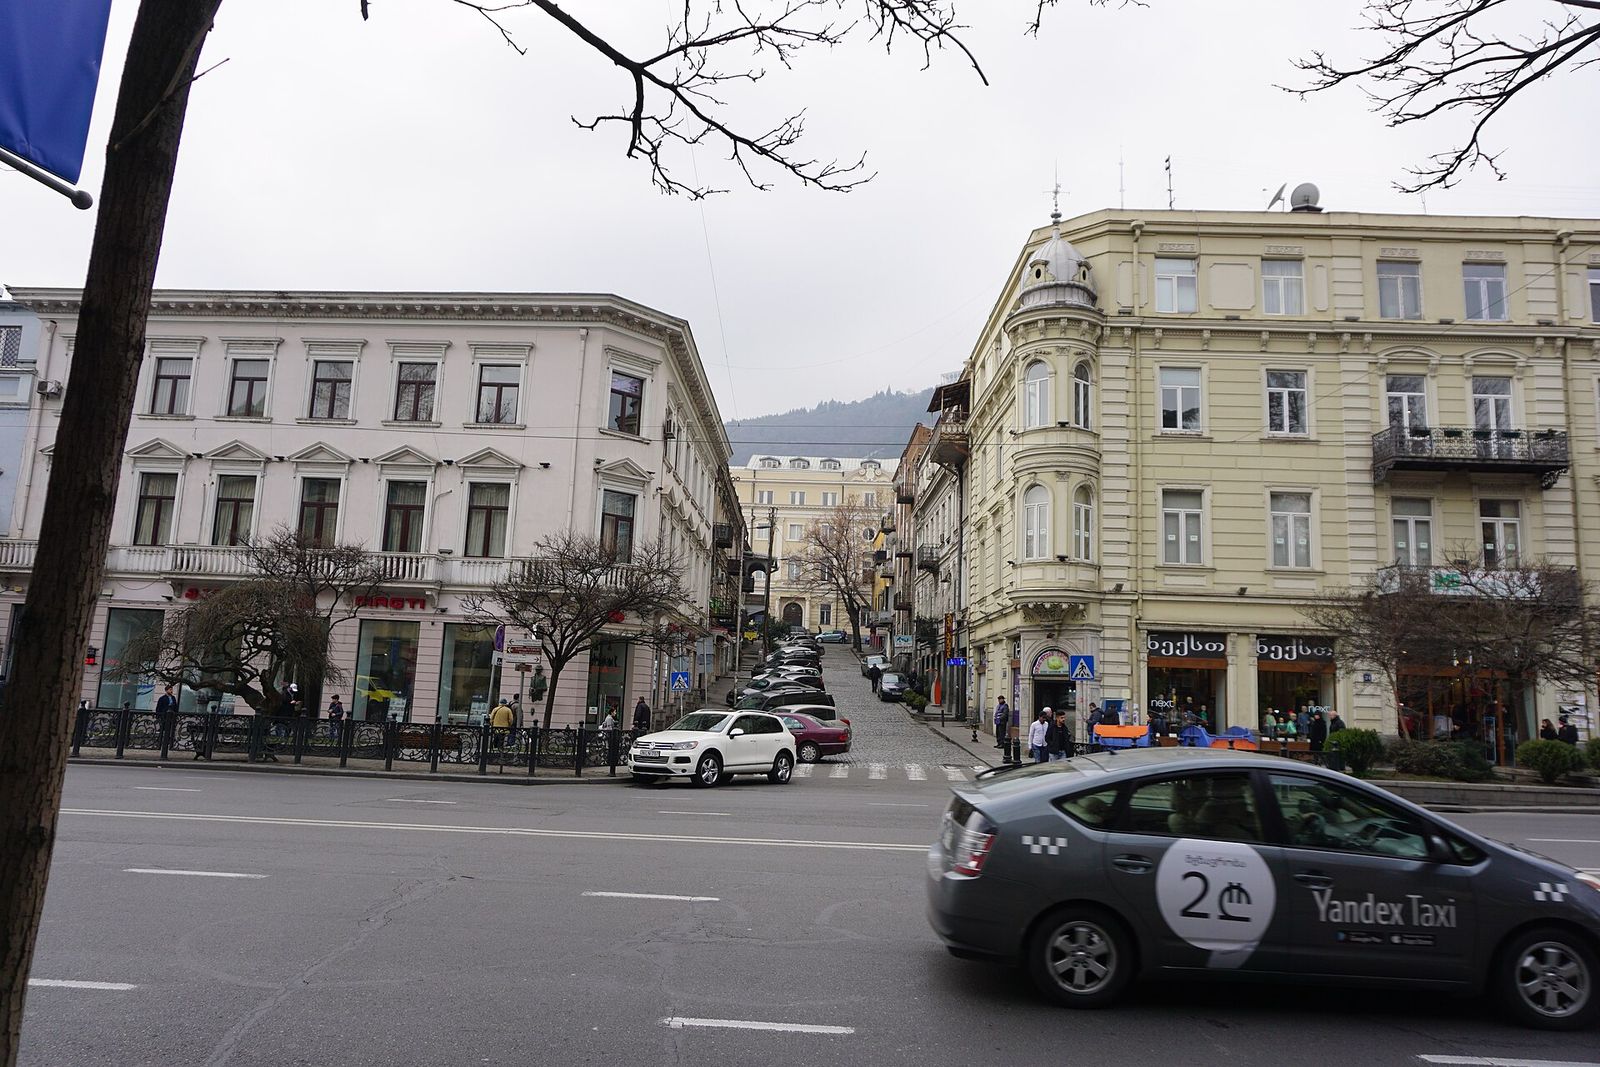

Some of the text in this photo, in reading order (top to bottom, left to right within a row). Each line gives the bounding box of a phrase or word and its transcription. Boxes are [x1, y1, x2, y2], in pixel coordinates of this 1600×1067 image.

[1147, 634, 1225, 657] ნექსთ
[1151, 699, 1175, 708] next
[1308, 705, 1331, 714] next
[1312, 889, 1457, 928] Yandex Taxi
